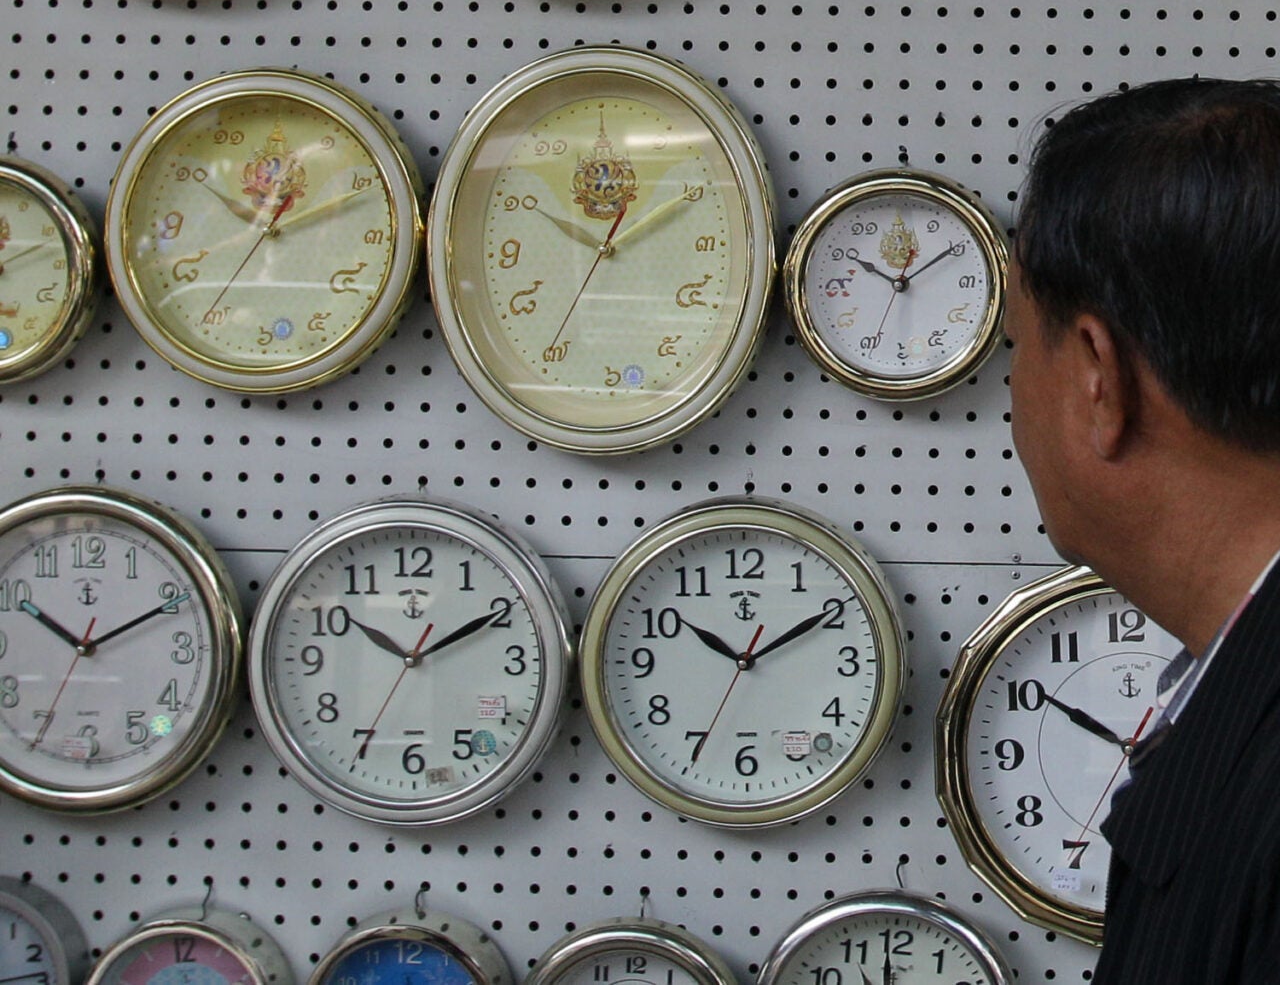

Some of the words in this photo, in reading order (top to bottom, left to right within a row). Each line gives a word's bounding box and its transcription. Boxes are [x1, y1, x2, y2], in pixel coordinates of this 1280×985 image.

[34, 545, 58, 578] 11
[71, 535, 106, 568] 12
[394, 547, 433, 577] 12
[725, 548, 764, 579] 12
[344, 565, 380, 595] 11
[675, 566, 711, 596] 11
[311, 605, 350, 636] 10
[641, 608, 681, 638] 10
[1108, 610, 1146, 643] 12
[1051, 632, 1079, 663] 11
[1112, 663, 1128, 672] KING
[1130, 663, 1145, 671] TIME
[157, 679, 181, 711] 4
[317, 693, 338, 722] 8
[648, 695, 670, 725] 8
[1008, 680, 1046, 712] 10
[125, 711, 147, 744] 5
[402, 744, 424, 774] 6
[735, 746, 758, 776] 6
[994, 739, 1024, 771] 9
[1015, 795, 1043, 827] 8
[26, 944, 42, 963] 2
[174, 937, 196, 963] 12
[396, 939, 422, 965] 12
[879, 930, 913, 955] 12
[626, 957, 646, 974] 12
